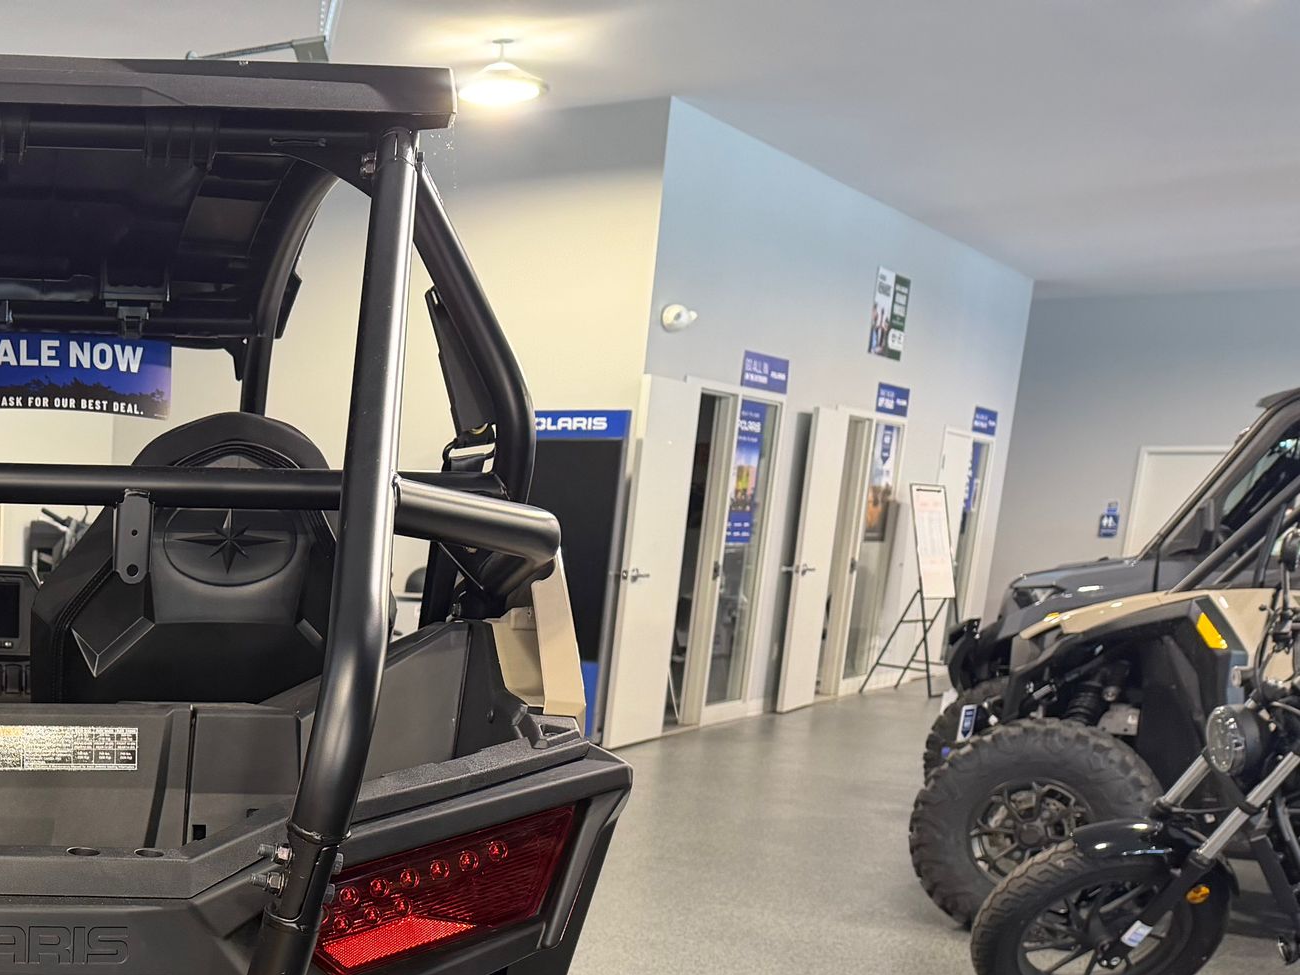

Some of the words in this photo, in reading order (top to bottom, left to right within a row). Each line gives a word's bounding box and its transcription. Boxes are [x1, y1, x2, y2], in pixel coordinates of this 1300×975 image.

[69, 340, 144, 374] NOW
[0, 396, 23, 407] ASK
[27, 396, 49, 408] FOR
[53, 397, 76, 409] OUR
[80, 398, 108, 411] BEST
[112, 401, 144, 415] DEAL.
[534, 416, 608, 431] OLARIS
